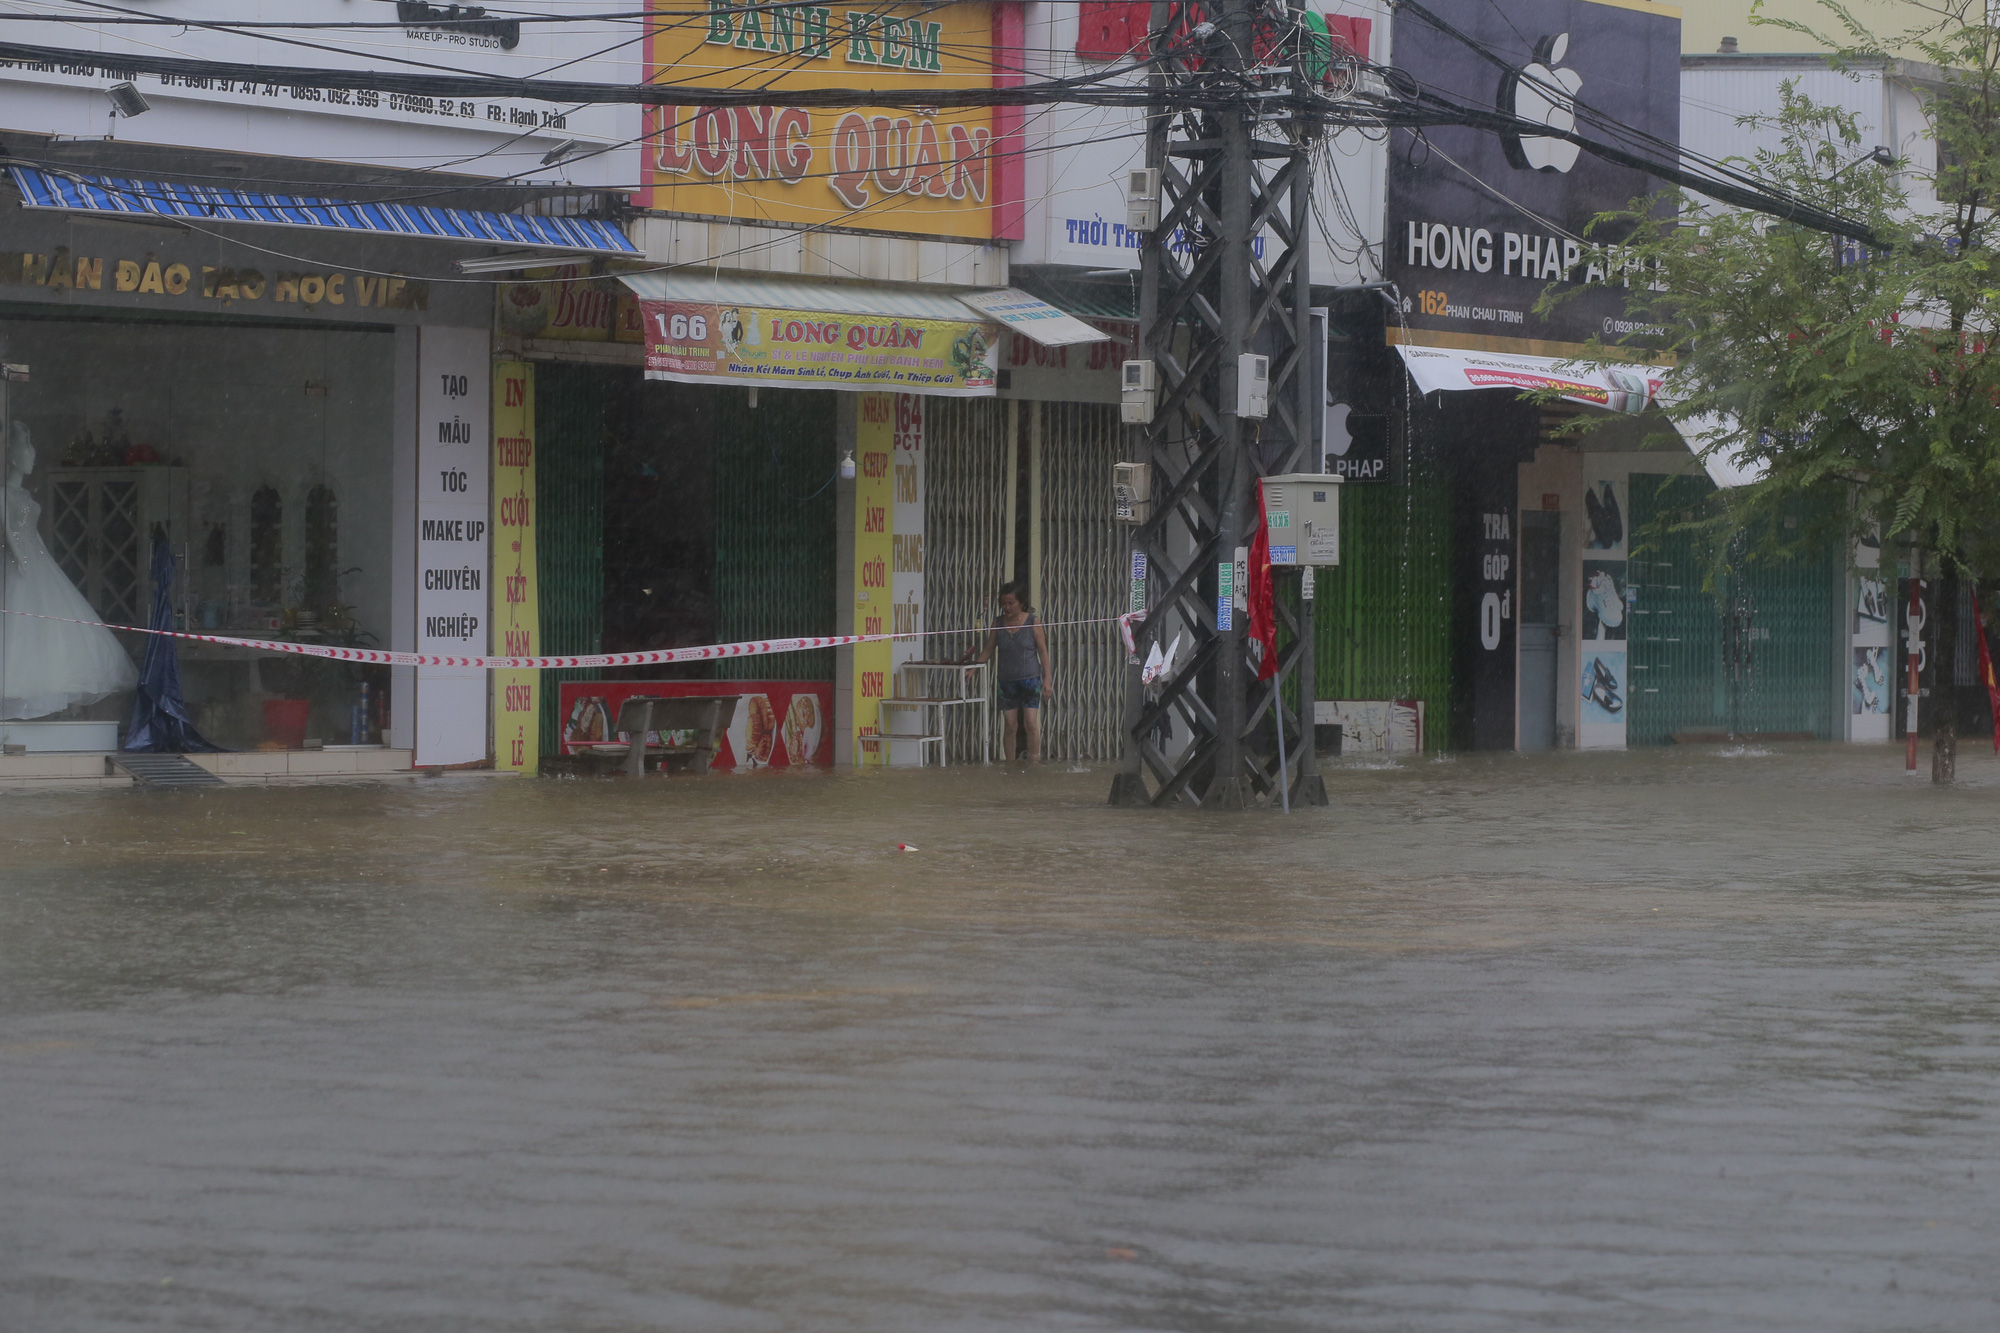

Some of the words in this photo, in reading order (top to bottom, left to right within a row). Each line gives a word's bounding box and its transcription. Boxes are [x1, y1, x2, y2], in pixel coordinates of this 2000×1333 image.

[407, 30, 430, 41] MAKE
[431, 33, 443, 42] UP
[449, 36, 466, 45] PRO
[469, 38, 499, 49] STUDIO
[844, 11, 942, 72] KEM
[487, 104, 506, 122] FB:
[510, 107, 538, 128] Hạnh
[541, 108, 566, 130] Trần
[657, 104, 812, 185] LONG
[1066, 212, 1107, 247] THỜI
[1408, 221, 1492, 273] HONG
[1504, 231, 1581, 282] PHAP
[201, 266, 266, 307] TẠO
[275, 270, 345, 313] HỌC
[1418, 290, 1448, 316] 162
[1446, 305, 1470, 319] PHAN
[1472, 307, 1496, 321] CHAU
[1498, 310, 1523, 324] TRINH
[655, 312, 707, 341] 166
[770, 318, 841, 346] LONG
[846, 319, 926, 351] QUÂN
[1614, 320, 1633, 333] 0928
[689, 346, 710, 357] TRINH
[784, 350, 792, 360] &
[810, 350, 844, 363] NGUYÊN
[847, 353, 869, 367] PHỤ
[870, 354, 889, 367] LIỆU
[890, 353, 920, 368] BÁNH
[922, 358, 944, 369] KEM
[441, 375, 468, 400] TẠO
[728, 363, 754, 375] Nhận
[756, 363, 771, 374] Kết
[772, 365, 796, 376] Mâm
[828, 368, 852, 380] Chụp
[854, 367, 871, 379] Ảnh
[893, 371, 904, 380] In
[907, 372, 931, 384] Thiệp
[504, 378, 526, 407] IN
[863, 391, 889, 431] NHẬN
[894, 392, 921, 432] 164
[439, 415, 470, 444] MẪU
[894, 434, 922, 450] PCT
[498, 429, 532, 476] THIỆP
[863, 452, 888, 486] CHỤP
[1336, 459, 1384, 478] PHAP
[441, 467, 467, 492] TÓC
[895, 453, 917, 504] THỜI
[501, 488, 530, 527] CƯỚI
[864, 496, 885, 533] ẢNH
[1483, 507, 1510, 540] TRẢ
[422, 520, 462, 541] MAKE
[466, 521, 485, 541] UP
[892, 534, 922, 573] TRANG
[1236, 560, 1246, 570] PC
[1483, 549, 1509, 580] GÓP
[425, 566, 480, 590] CHUYÊN
[506, 567, 527, 602] KẾT
[863, 554, 885, 588] CƯỚI
[427, 613, 478, 642] NGHIỆP
[893, 589, 919, 642] XUẤT
[505, 622, 530, 657] MÂM
[506, 677, 530, 711] SÍNH
[861, 672, 884, 697] SINH
